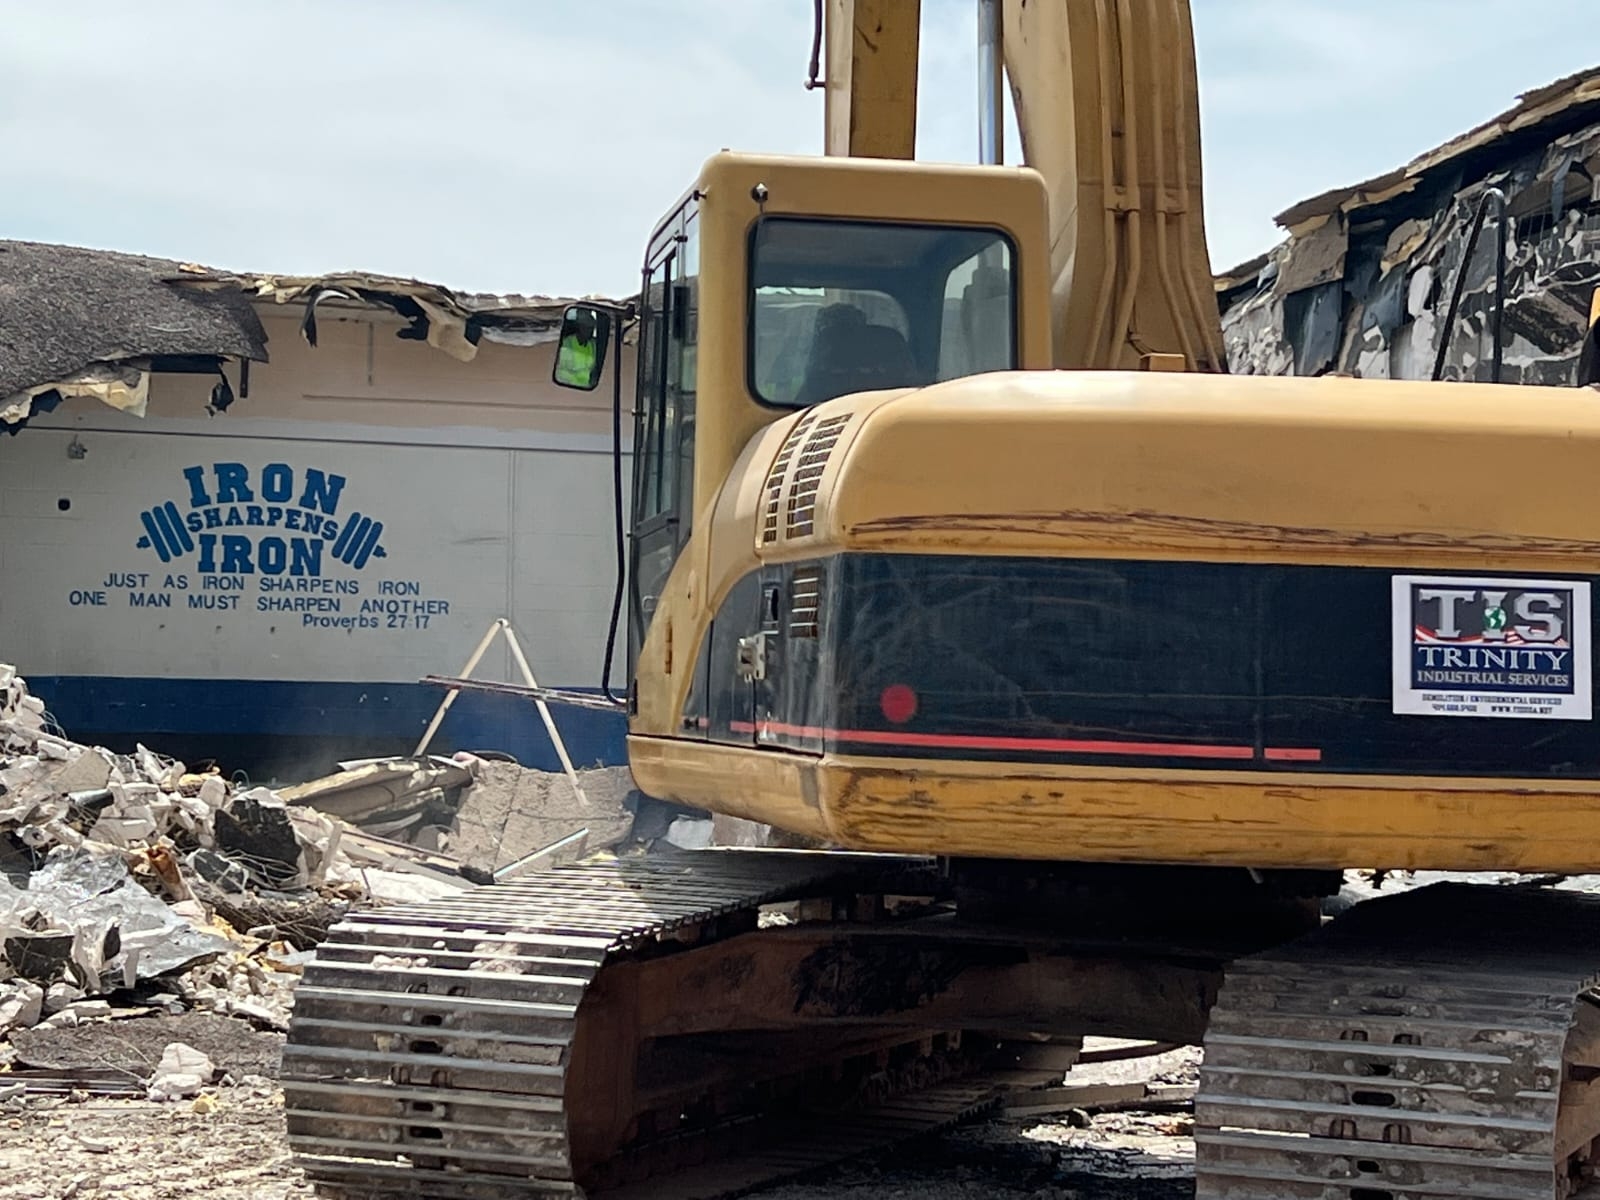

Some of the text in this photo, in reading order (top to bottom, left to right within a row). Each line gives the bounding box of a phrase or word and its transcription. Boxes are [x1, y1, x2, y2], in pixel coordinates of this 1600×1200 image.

[184, 463, 346, 515] IRON
[187, 507, 339, 541] SHARPENS
[198, 534, 324, 577] IRON
[104, 573, 420, 596] JUST AS IRON SHARPENS IRON
[69, 591, 449, 615] ONE MAN MUST SHARPEN ANOTHER
[1418, 588, 1565, 642] TIS
[302, 613, 379, 629] Proverbs
[1418, 647, 1568, 671] TRINITY
[1417, 670, 1569, 687] INDUSTRIAL SERVICES
